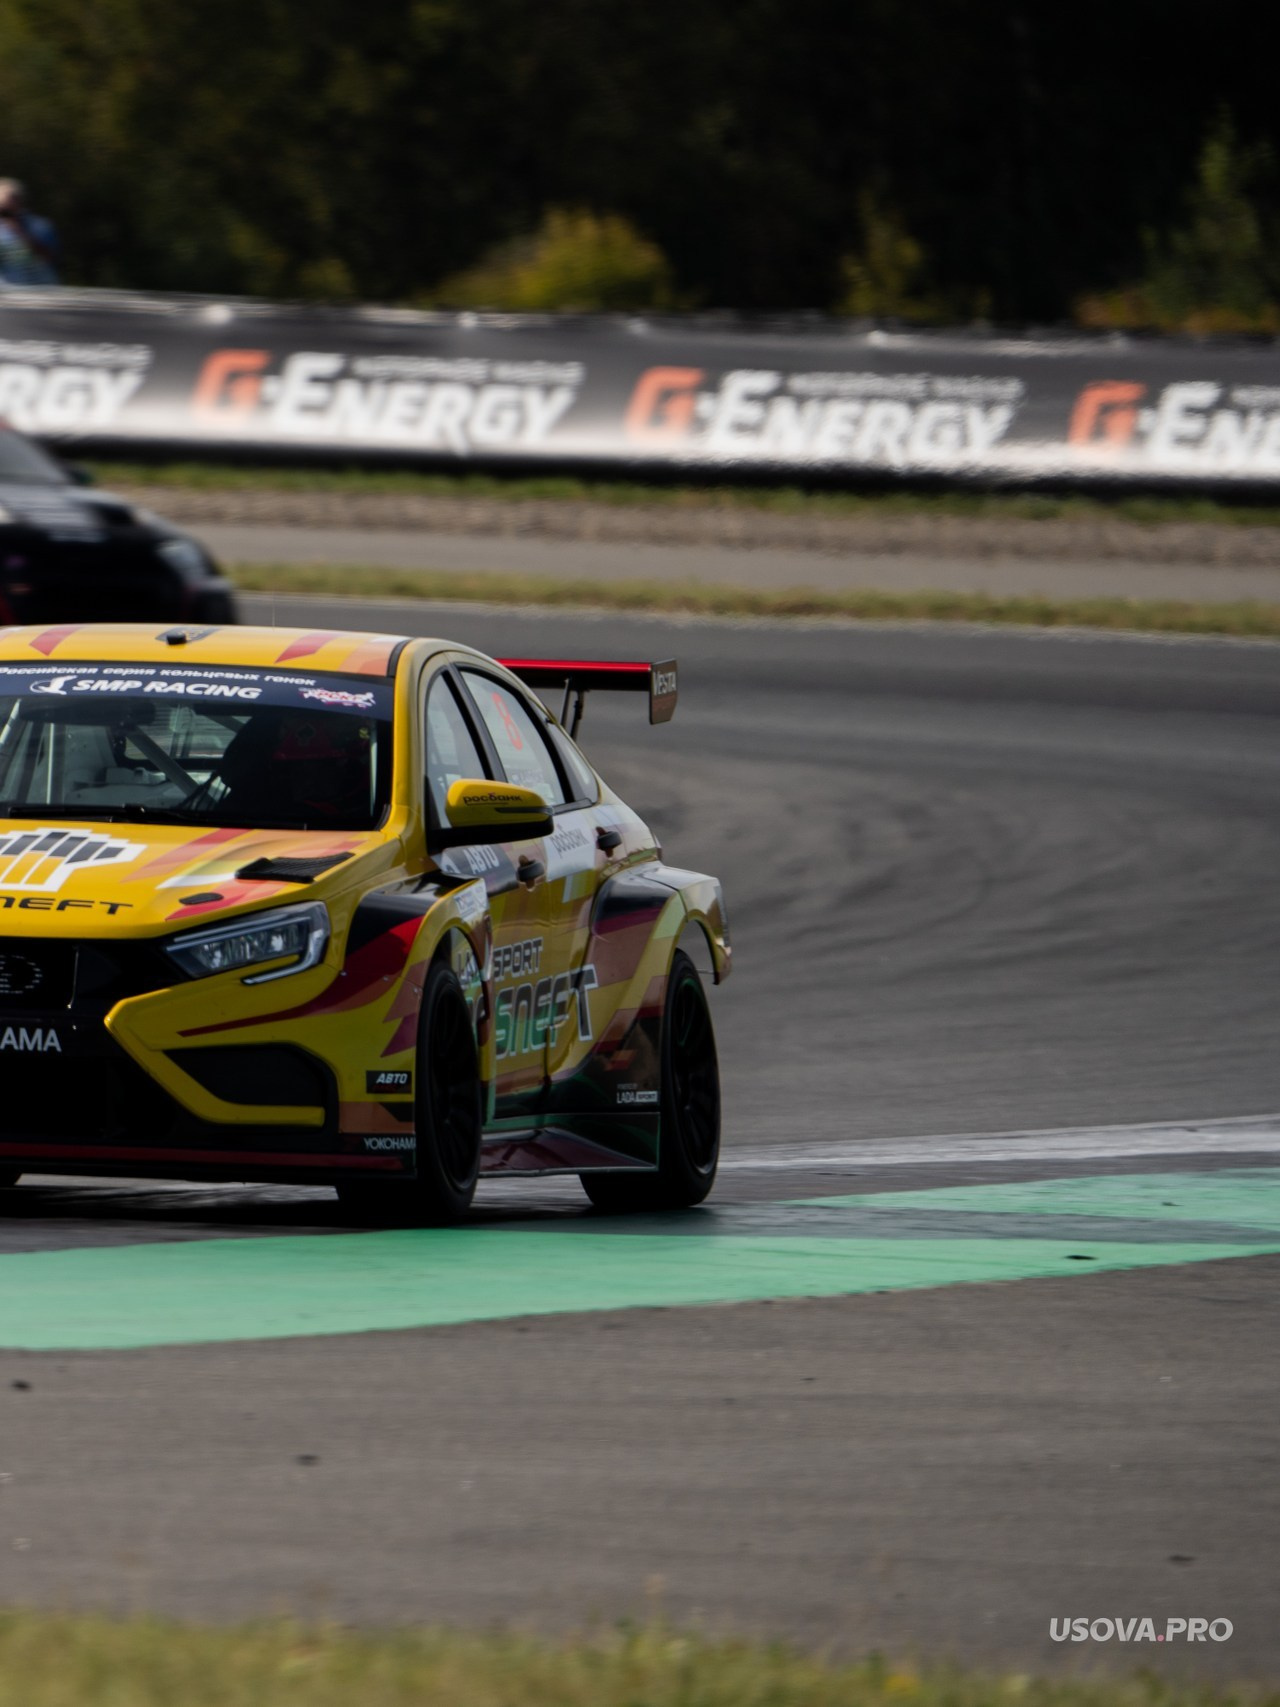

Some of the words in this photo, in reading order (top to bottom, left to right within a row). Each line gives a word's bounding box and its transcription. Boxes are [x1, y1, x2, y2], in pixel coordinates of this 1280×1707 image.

[191, 348, 577, 457] G-ENERGY
[625, 366, 1020, 471] G-ENERGY
[72, 679, 142, 692] SMP
[143, 680, 263, 699] RACING
[103, 667, 156, 676] серия
[160, 669, 260, 681] кольцевых
[264, 674, 317, 686] гонок
[653, 671, 677, 696] VESTA
[491, 691, 524, 751] 8
[463, 844, 500, 874] АВТО
[493, 936, 544, 982] SPORT
[465, 963, 599, 1060] SNEFT
[375, 1072, 408, 1085] АВТО
